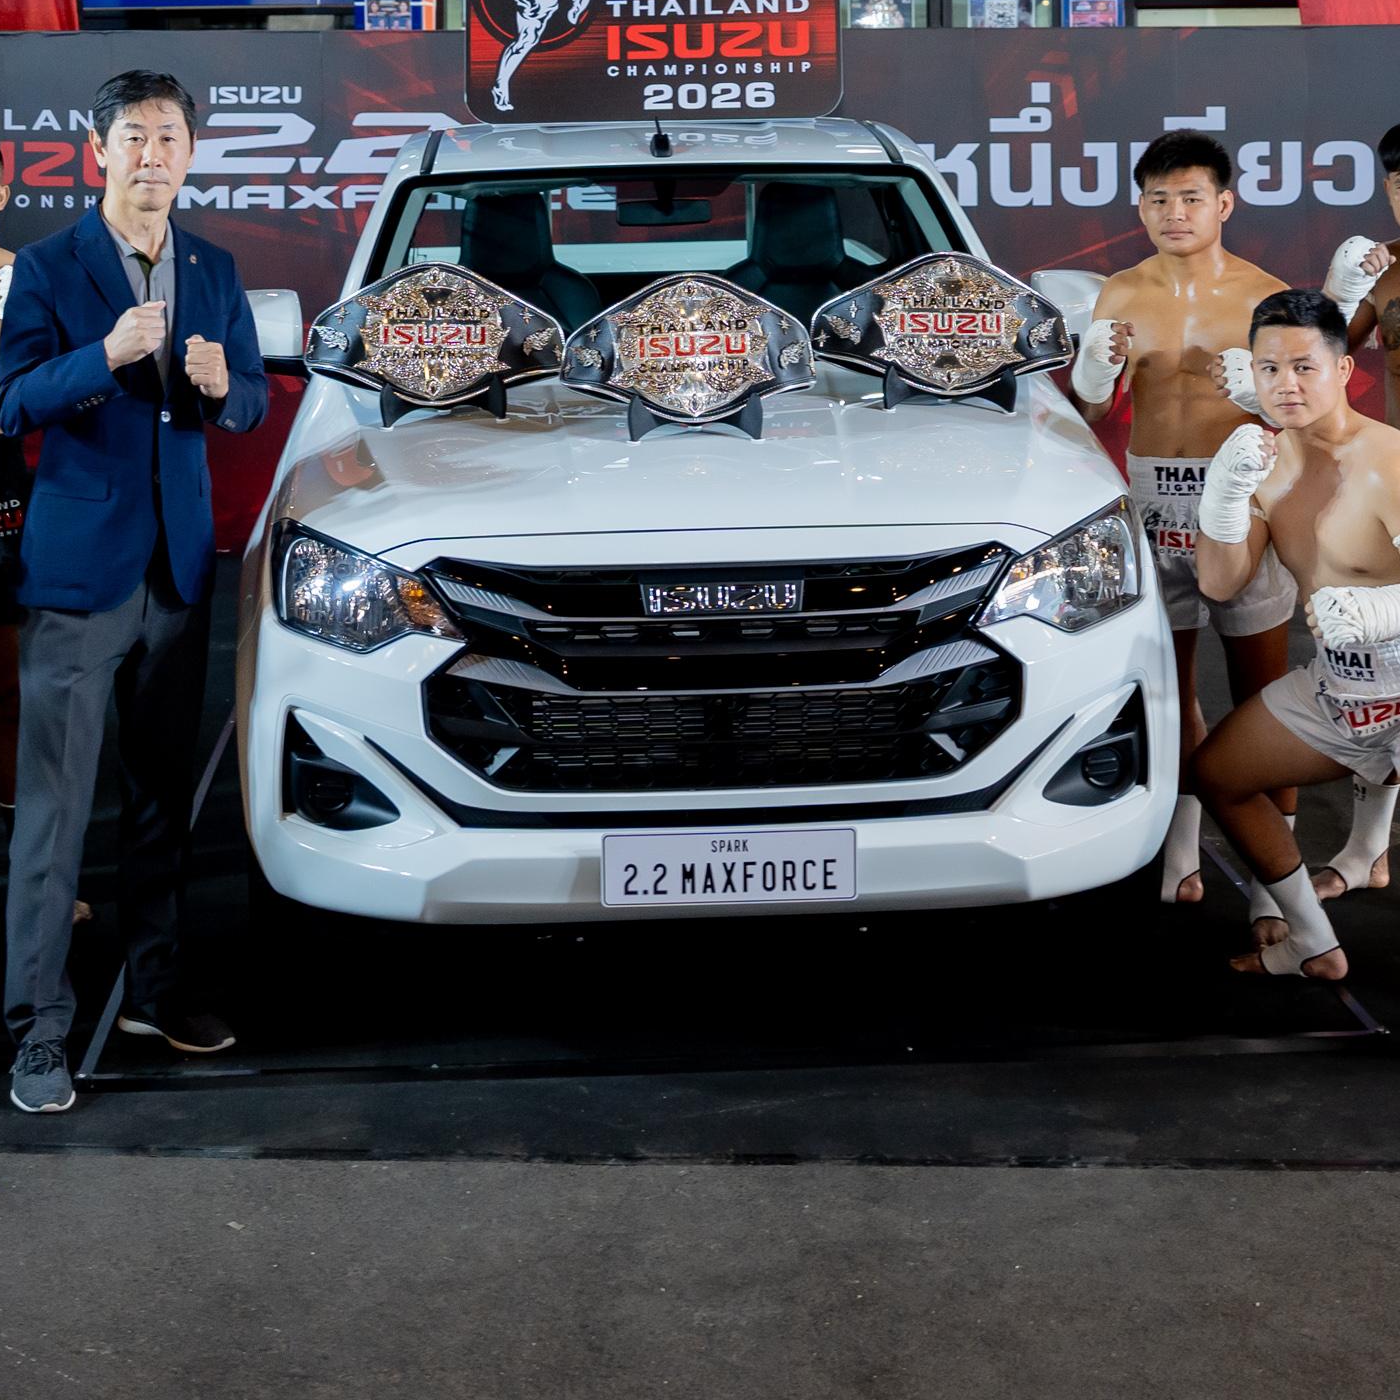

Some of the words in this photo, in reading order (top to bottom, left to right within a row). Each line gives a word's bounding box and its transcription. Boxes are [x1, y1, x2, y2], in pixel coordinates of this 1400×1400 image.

[607, 21, 810, 60] ISUZU
[607, 62, 811, 77] CHAMPIONSHIP
[209, 86, 302, 104] ISUZU
[643, 82, 776, 110] 2026
[900, 297, 1005, 309] THAILAND
[637, 320, 749, 335] THAILAND
[899, 313, 1001, 333] ISUZU
[382, 325, 487, 345] ISUZU
[638, 333, 747, 358] ISUZU
[1154, 466, 1206, 483] THAI
[649, 585, 796, 612] ISUZU
[1325, 647, 1371, 669] THAI
[711, 840, 749, 852] SPARK
[624, 863, 667, 895] 2.2
[681, 859, 837, 894] MAXFORCE
